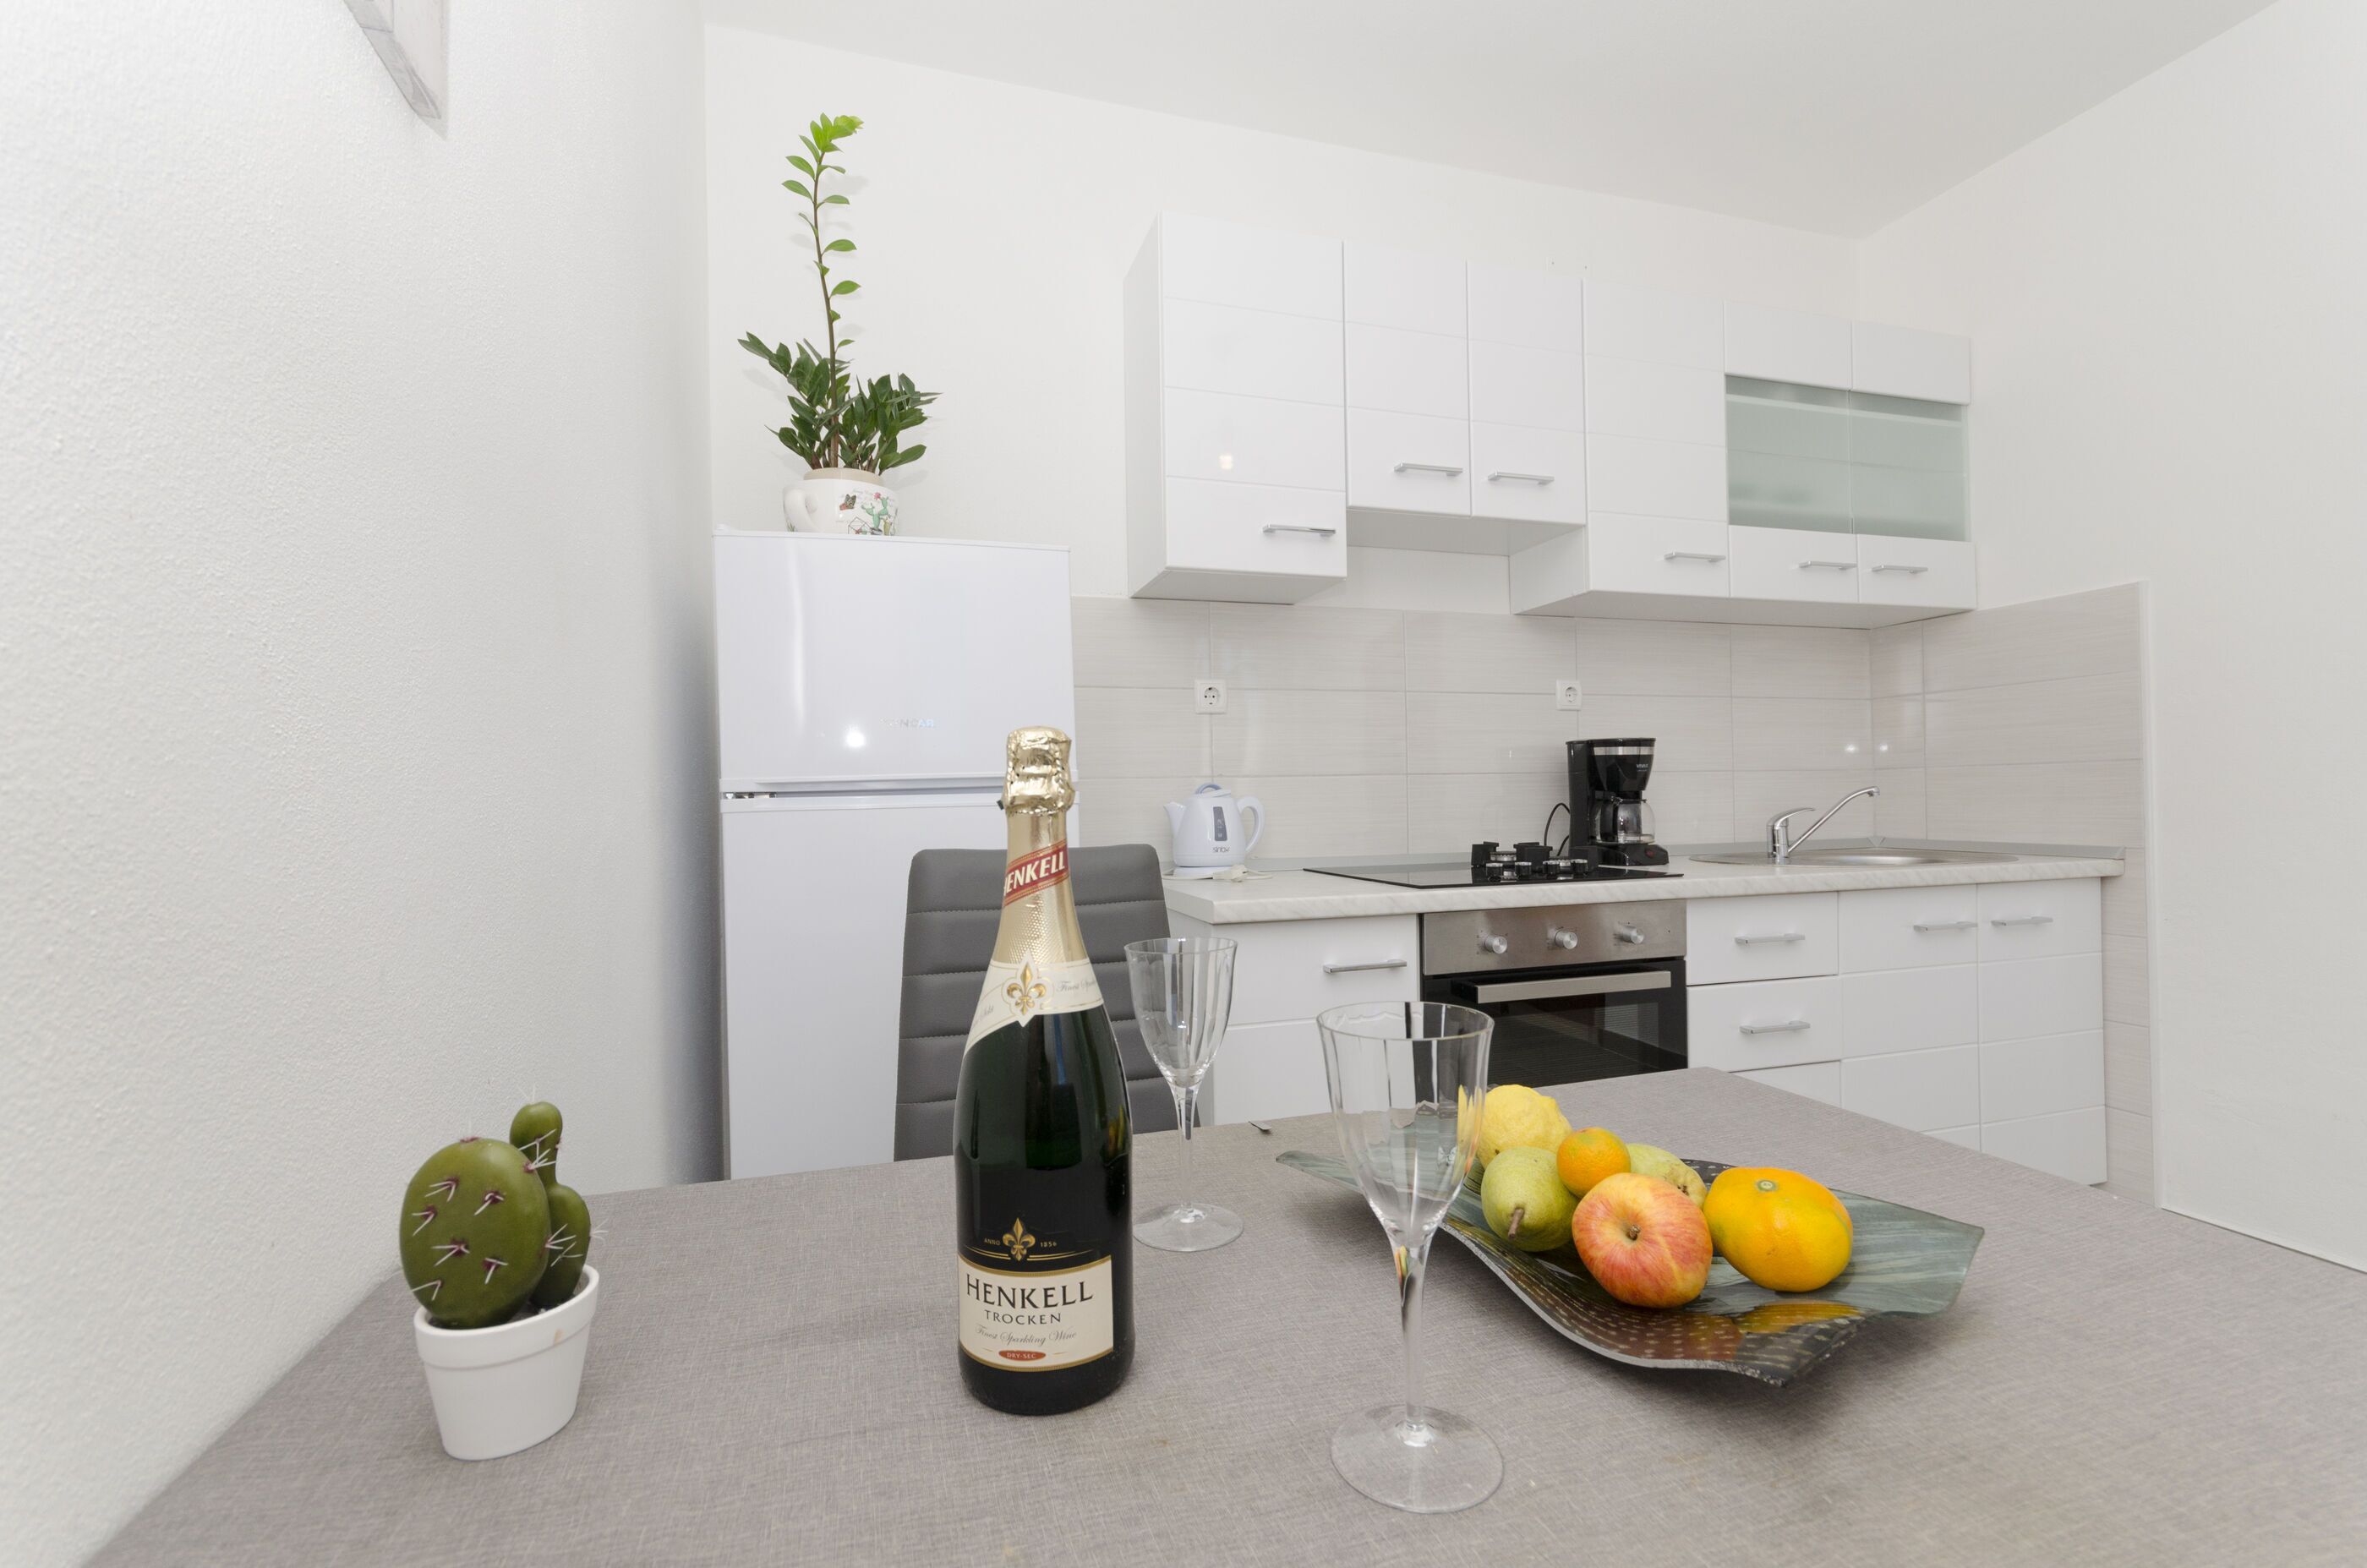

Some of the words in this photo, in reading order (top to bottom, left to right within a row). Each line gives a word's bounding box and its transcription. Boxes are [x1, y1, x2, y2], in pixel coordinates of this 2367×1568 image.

[984, 1237, 1001, 1246] ANNO
[966, 1273, 1094, 1309] HENKELL
[984, 1309, 1062, 1325] TROCKEN
[974, 1323, 998, 1339] Finest
[999, 1330, 1047, 1347] Sparkling
[1048, 1325, 1077, 1341] Wine
